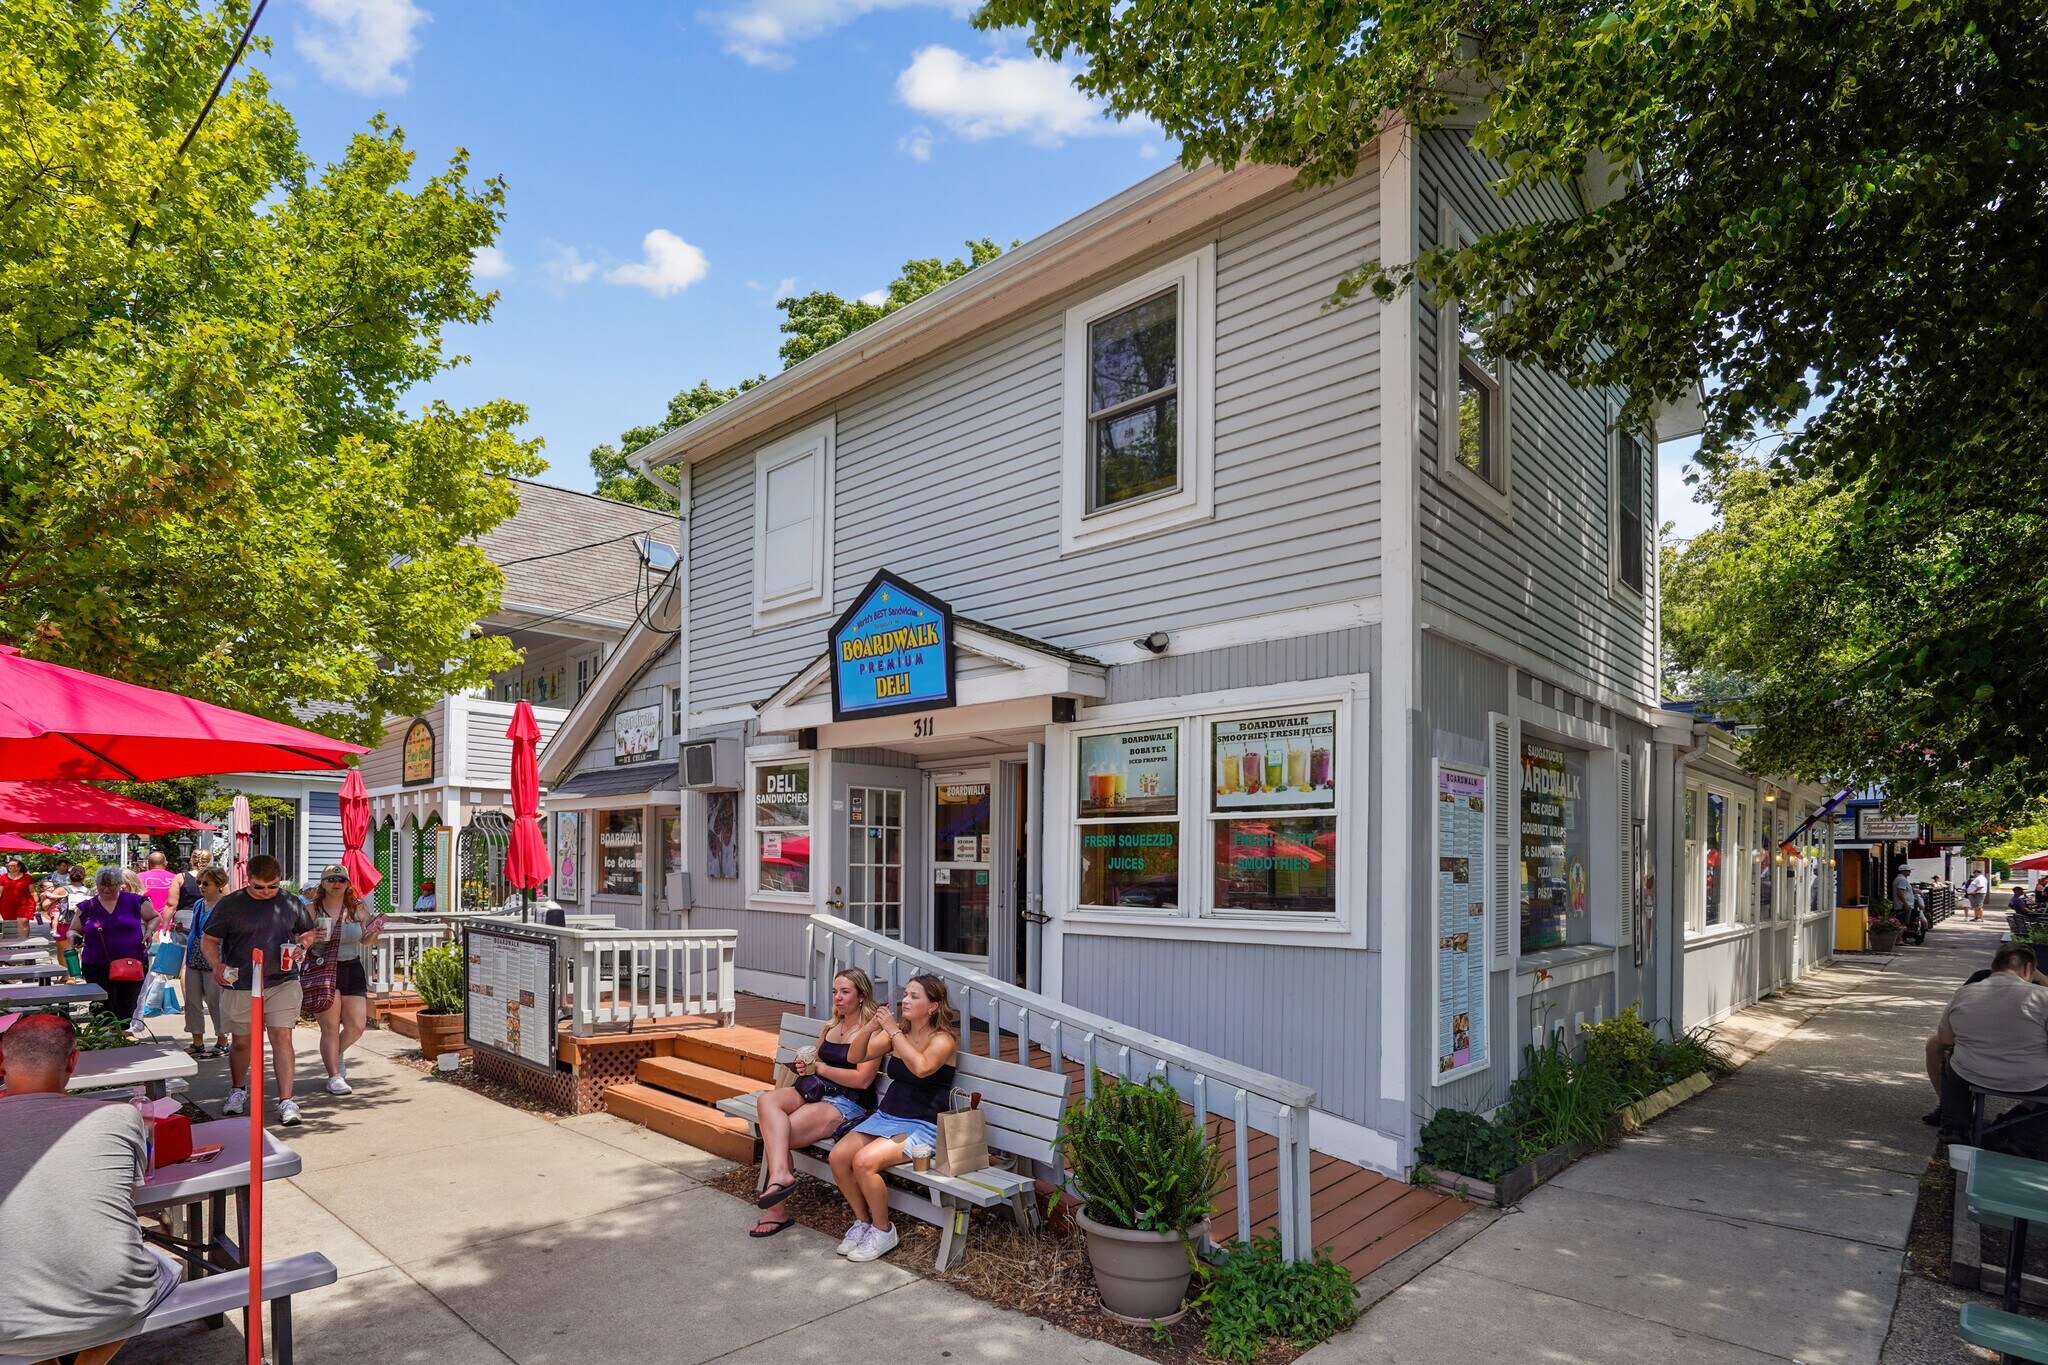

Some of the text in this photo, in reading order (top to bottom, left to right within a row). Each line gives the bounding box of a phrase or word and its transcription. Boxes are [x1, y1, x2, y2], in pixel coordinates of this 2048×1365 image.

[857, 606, 918, 629] World's BEST Sandwiches
[841, 621, 940, 663] BOARDWALK
[859, 653, 924, 675] PREMIUM
[875, 671, 911, 699] DELI
[913, 716, 934, 738] 311
[1239, 717, 1309, 731] BOARDWALK
[1122, 732, 1173, 744] BOARDWALK
[1217, 726, 1333, 743] SMOOTHIES FRESH JUICES
[1129, 746, 1150, 755] BOBA
[767, 774, 796, 793] DELI
[1446, 773, 1478, 786] BOARDWALK
[946, 784, 986, 797] BOARDWALK
[756, 792, 808, 805] SANDWICHES
[1530, 801, 1560, 817] ICE CREAM
[1521, 821, 1567, 839] GOURMET WRAPS
[600, 832, 642, 845] BOARDWAL
[1084, 833, 1174, 848] FRESH SQUEEZED
[1233, 832, 1315, 847] FRESH FRUIT
[1525, 845, 1530, 858] &
[604, 856, 643, 868] Ice Cream
[1107, 857, 1145, 870] JUICES
[1237, 857, 1311, 871] SMOOTHIES
[1537, 866, 1551, 878] PIZZA
[1537, 887, 1553, 899] PASTA
[494, 937, 520, 948] BOARDWALK
